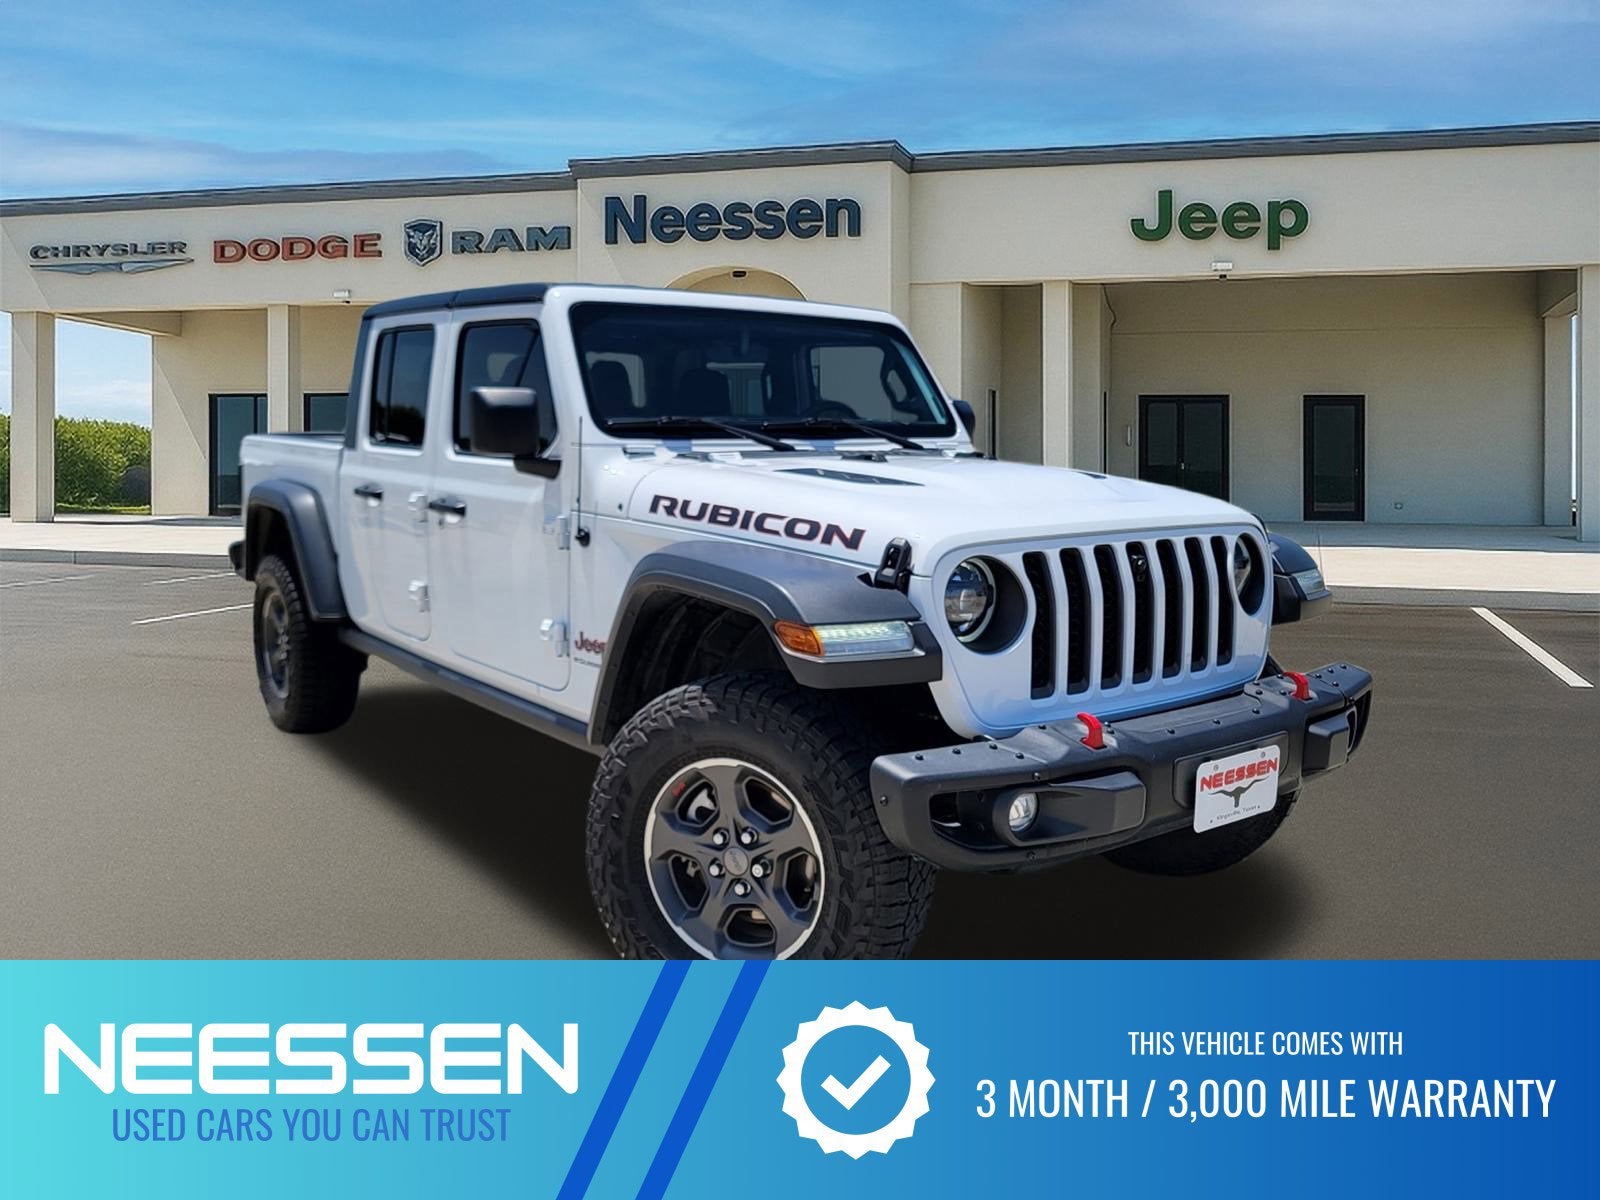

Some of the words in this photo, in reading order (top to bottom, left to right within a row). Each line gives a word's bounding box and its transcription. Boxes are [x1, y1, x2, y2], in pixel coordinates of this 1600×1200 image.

[604, 195, 862, 245] Neessen
[1130, 189, 1310, 251] Jeep
[30, 241, 188, 259] CHRYSLER
[213, 233, 383, 264] DODGE
[451, 225, 572, 255] RAM
[648, 494, 866, 551] RUBICON
[1200, 757, 1278, 792] NEESSEN
